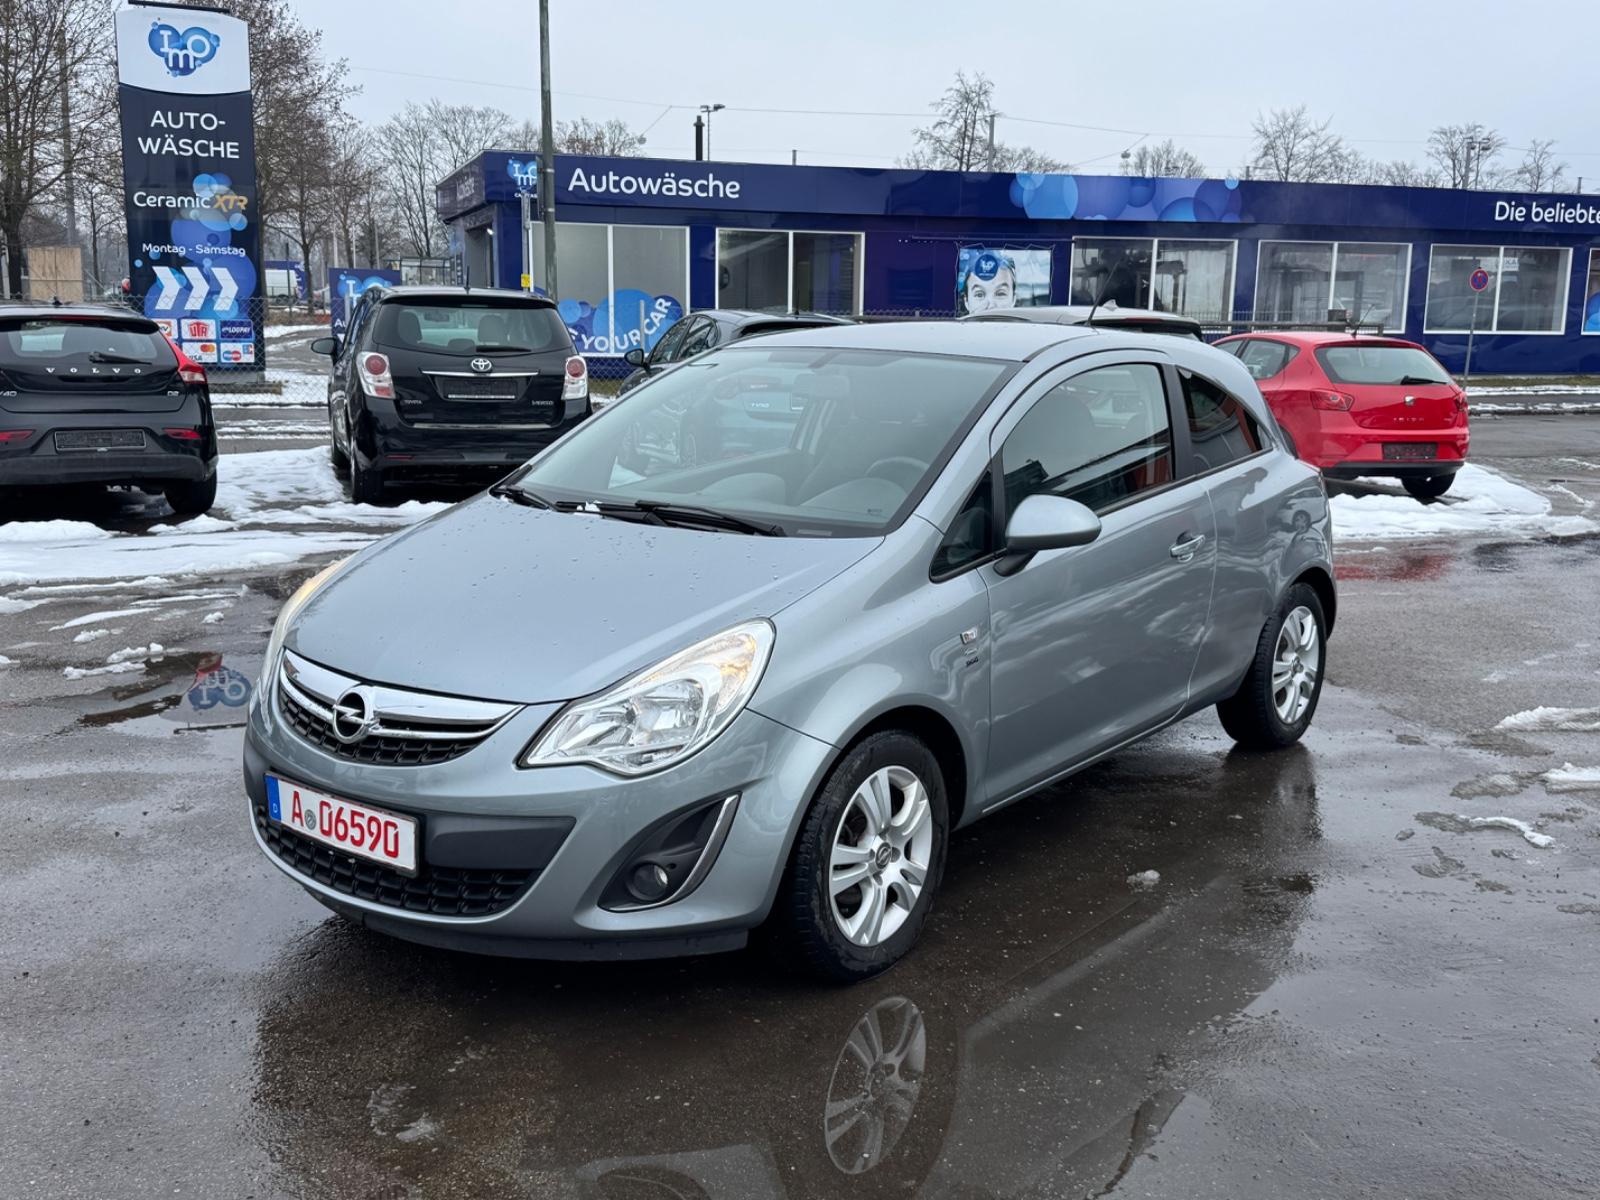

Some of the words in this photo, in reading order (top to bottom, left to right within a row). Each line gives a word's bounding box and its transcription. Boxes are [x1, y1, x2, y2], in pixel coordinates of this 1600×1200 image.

[150, 110, 226, 131] AUTO-
[137, 133, 240, 159] WÄSCHE
[567, 168, 740, 199] Autowäsche
[133, 191, 211, 209] Ceramic
[213, 194, 248, 213] XTR
[1494, 200, 1526, 221] Die
[142, 243, 186, 255] Montag
[195, 244, 246, 257] Samstag
[581, 328, 641, 352] YOUR
[643, 297, 672, 336] CAR
[291, 790, 304, 827] A
[319, 800, 400, 859] 06590
